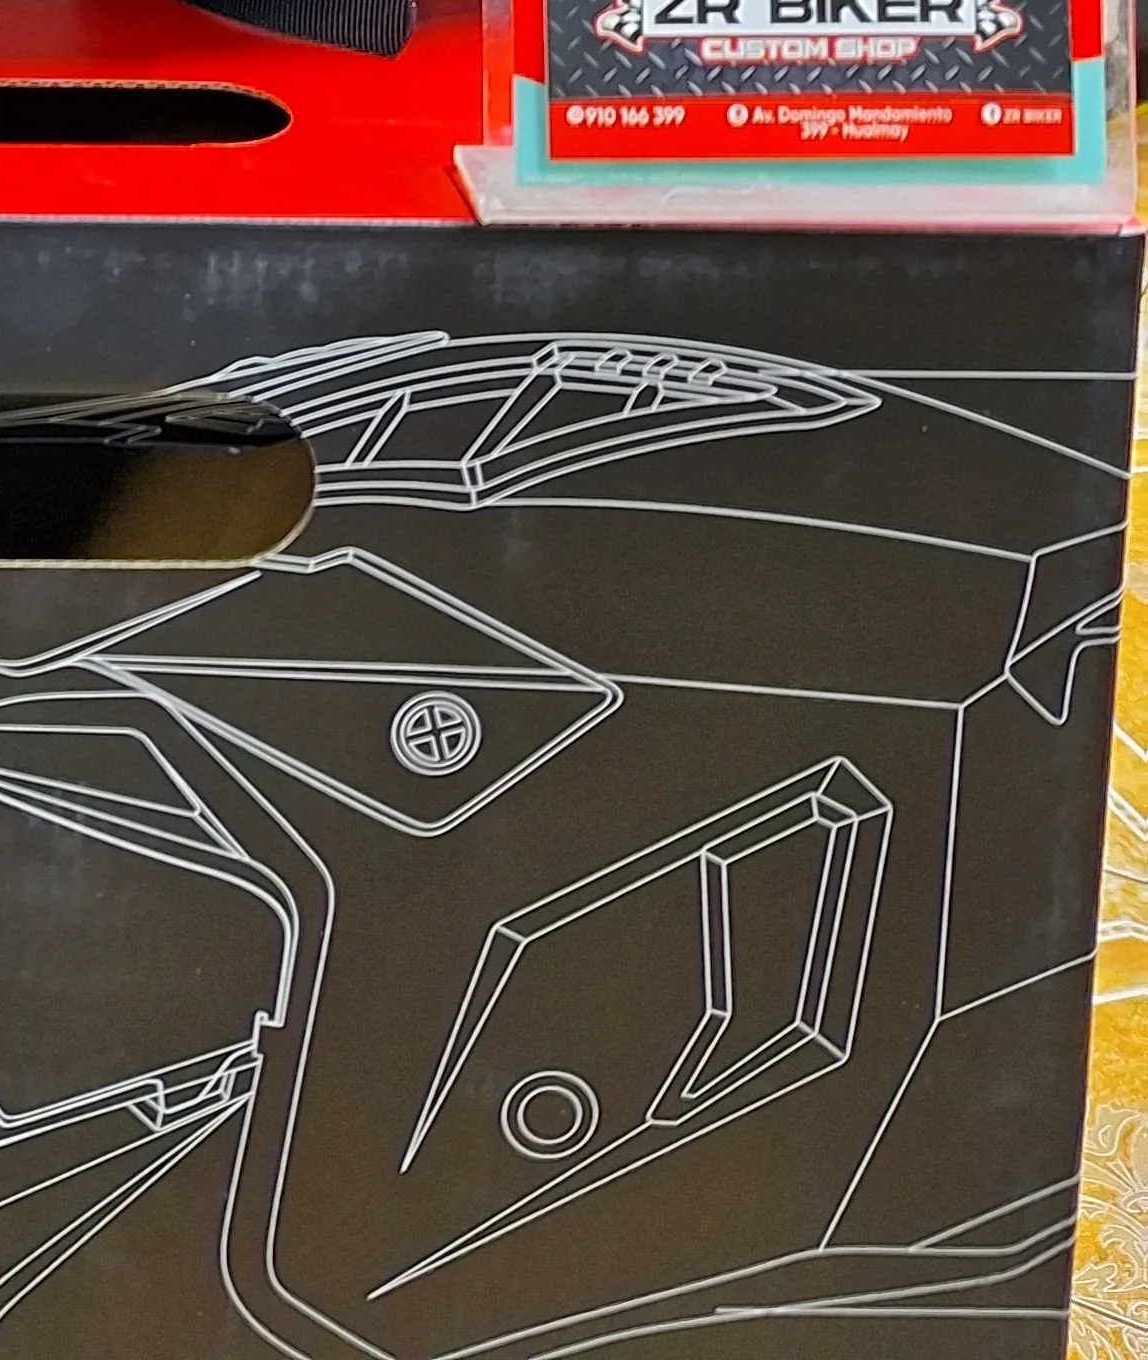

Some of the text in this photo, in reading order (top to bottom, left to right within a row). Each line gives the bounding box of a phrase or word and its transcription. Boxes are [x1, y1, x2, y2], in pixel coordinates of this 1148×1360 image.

[702, 37, 918, 61] CUSTOM SHOP
[585, 105, 686, 128] 910 166 399
[777, 105, 845, 127] Domingo
